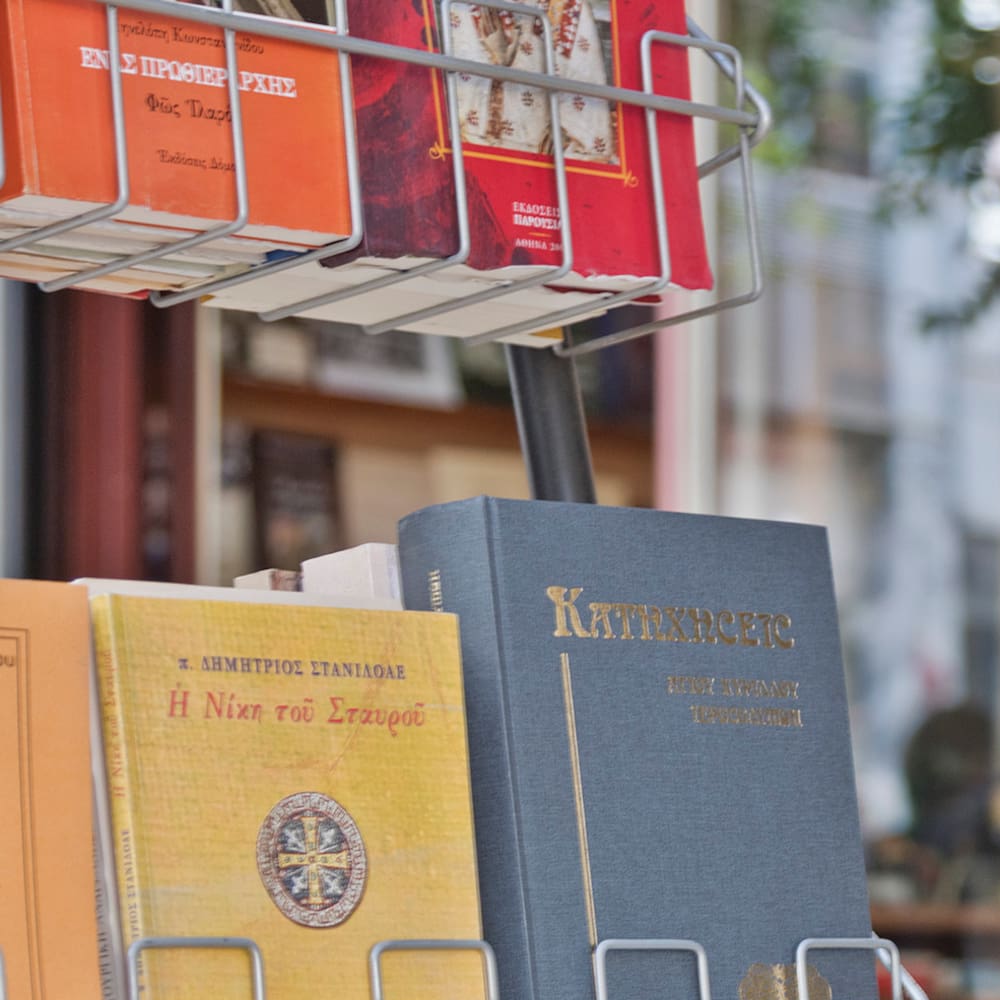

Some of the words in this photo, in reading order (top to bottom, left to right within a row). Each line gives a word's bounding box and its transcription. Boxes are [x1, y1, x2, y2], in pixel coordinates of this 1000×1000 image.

[80, 46, 137, 75] ΕΝΣ
[140, 56, 297, 98] ΠΡΩΘΙΕΡΡΧΗΣ
[201, 655, 304, 676] ΔΗΜΗΤΡΙΟΣ
[311, 660, 406, 680] ΣΤΑΝΙΛΟΑΕ
[203, 690, 263, 723] Νίκη
[274, 697, 314, 722] τοῦ
[327, 696, 426, 737] Σταυροῦ
